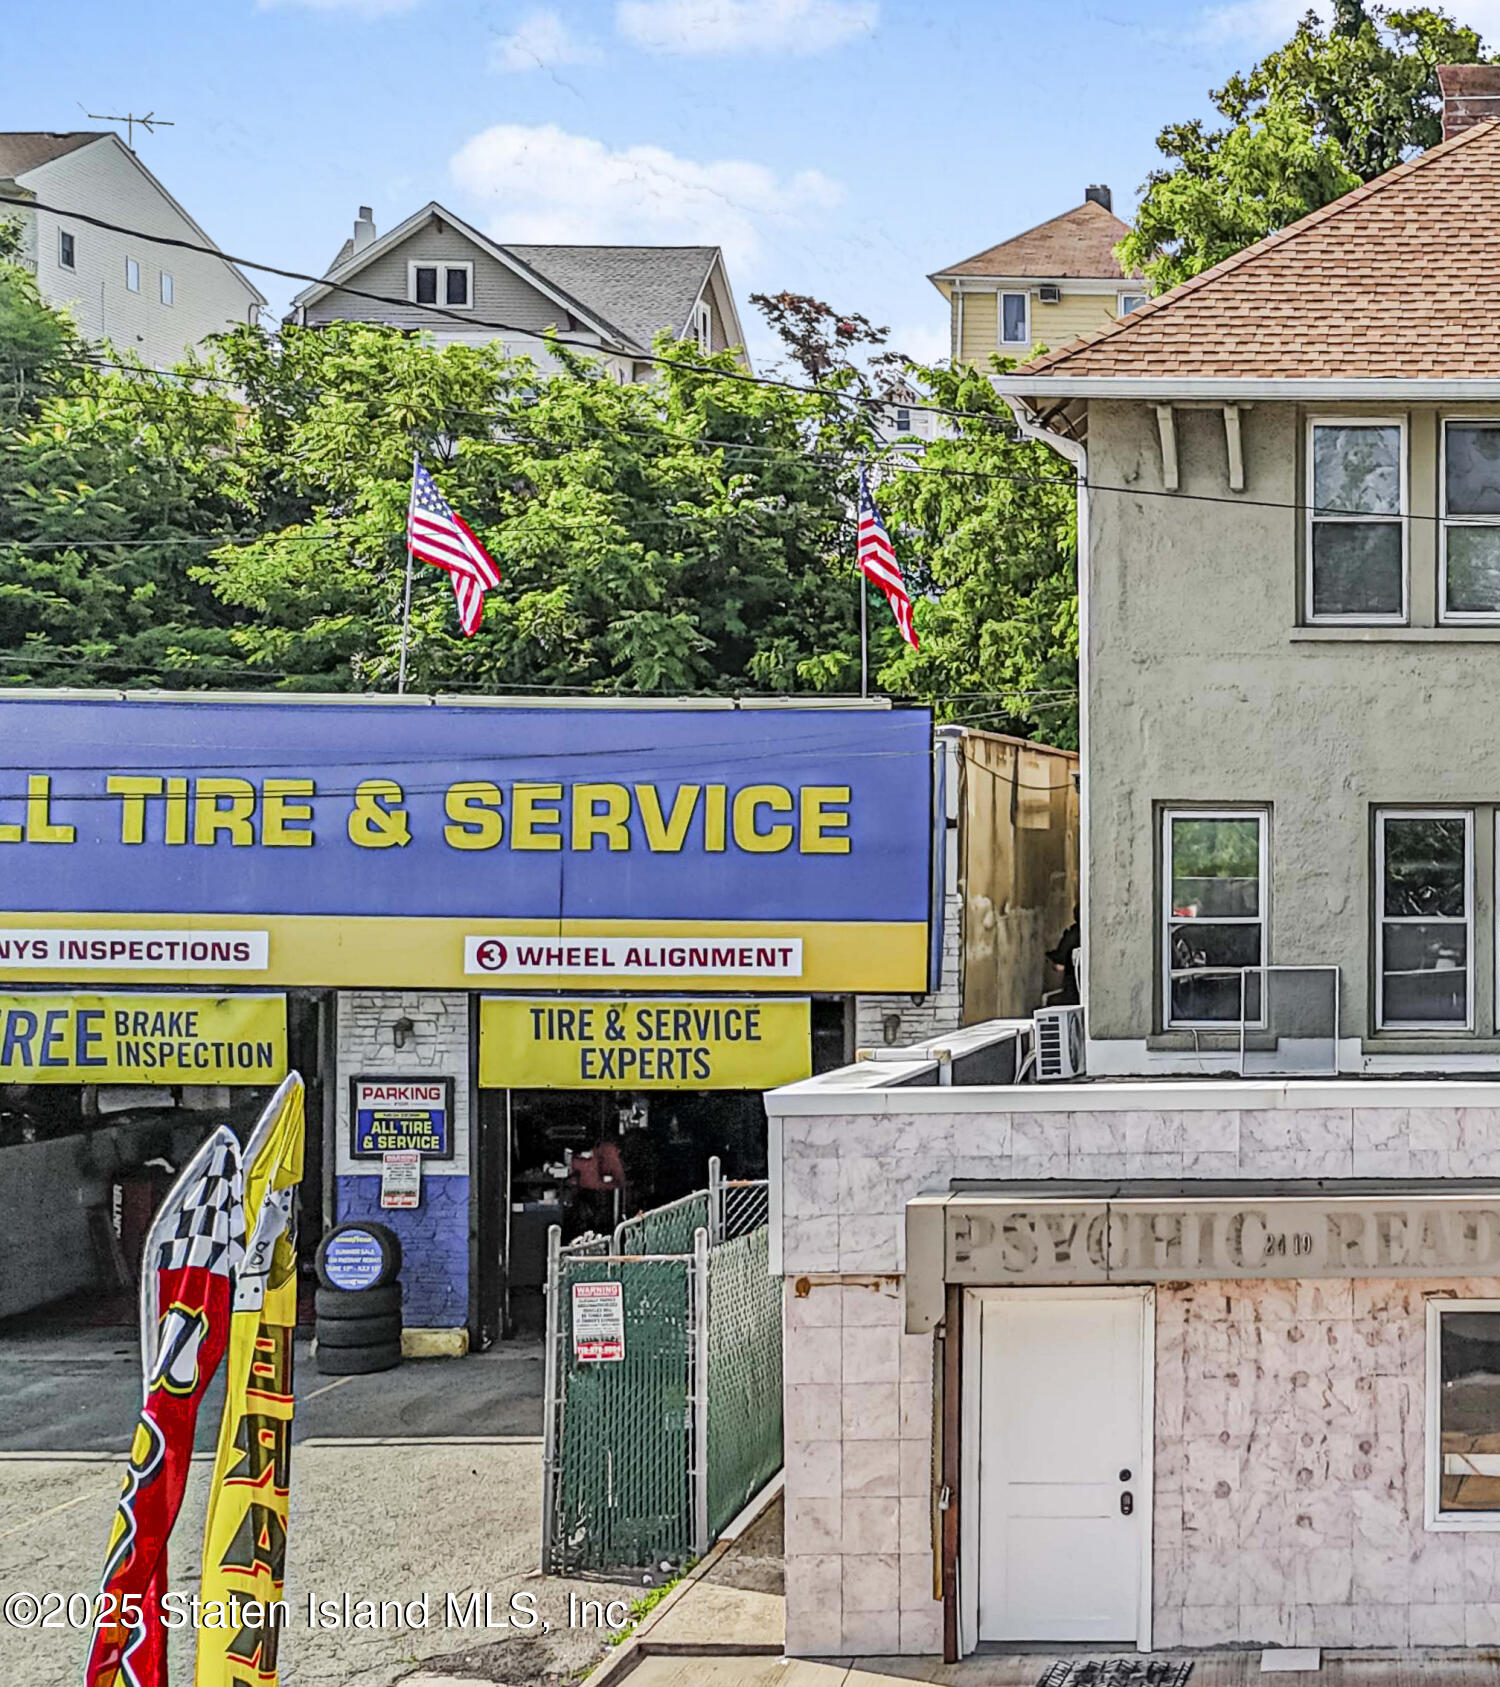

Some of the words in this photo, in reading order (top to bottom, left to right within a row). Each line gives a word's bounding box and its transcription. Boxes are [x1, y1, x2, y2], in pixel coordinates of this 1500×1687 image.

[106, 775, 315, 846] TIRE
[347, 780, 411, 848] &
[443, 781, 851, 854] SERVICE
[59, 940, 251, 962] INSPECTIONS
[516, 946, 616, 967] WHEEL
[624, 947, 794, 968] ALIGNMENT
[0, 1009, 108, 1067] REE
[114, 1010, 199, 1038] BRAKE
[530, 1008, 594, 1041] TIRE
[605, 1008, 626, 1042] &
[636, 1009, 762, 1042] SERVICE
[116, 1041, 273, 1069] INSPECTION
[581, 1048, 711, 1081] EXPERTS
[362, 1087, 441, 1100] PARKING
[371, 1121, 398, 1135] ALL
[400, 1121, 432, 1135] TIRE
[362, 1136, 374, 1149] &
[378, 1136, 440, 1149] SERVICE
[113, 1184, 122, 1238] UNTER
[949, 1210, 1268, 1272] PSYCHIC
